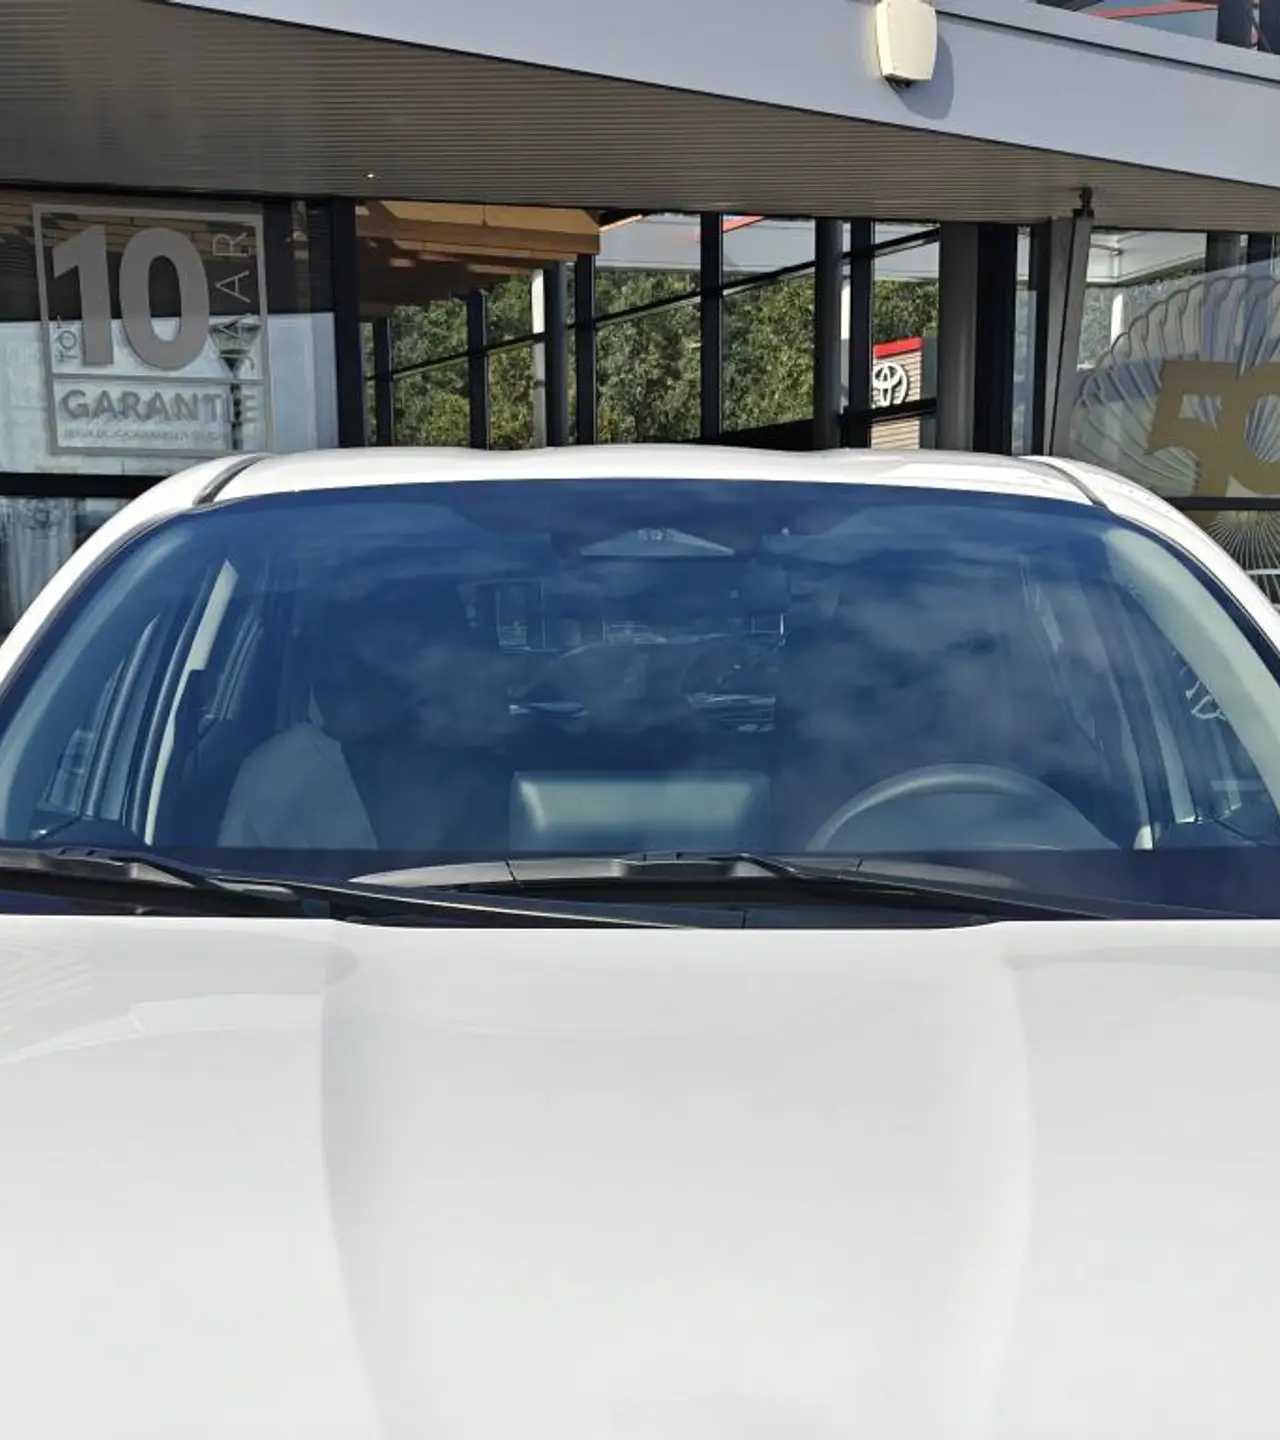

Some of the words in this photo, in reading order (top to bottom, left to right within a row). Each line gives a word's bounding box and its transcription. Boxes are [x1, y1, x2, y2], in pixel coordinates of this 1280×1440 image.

[51, 224, 211, 371] 10
[212, 231, 255, 372] JAAR
[60, 389, 257, 424] GARANTIE
